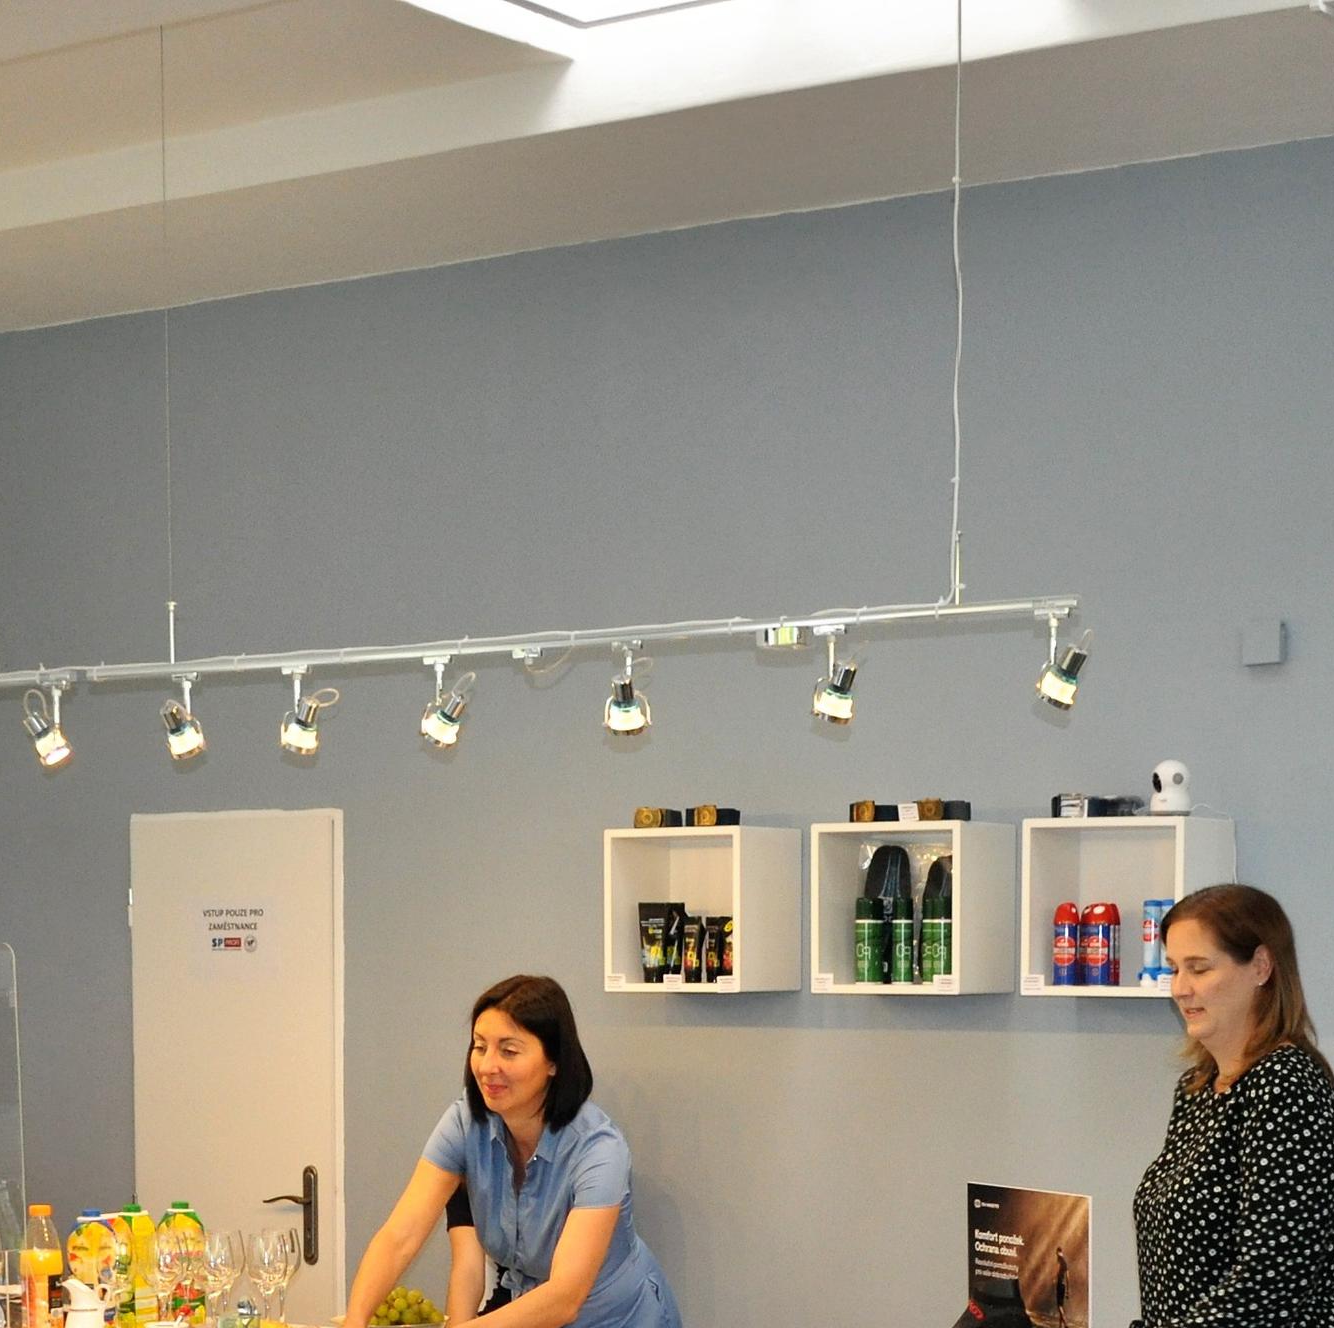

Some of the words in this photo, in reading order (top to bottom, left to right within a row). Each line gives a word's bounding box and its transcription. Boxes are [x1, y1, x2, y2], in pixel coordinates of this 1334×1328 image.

[202, 909, 224, 918] VSTUP
[225, 908, 248, 918] POUZE
[249, 908, 264, 917] PRO
[212, 938, 223, 947] SP
